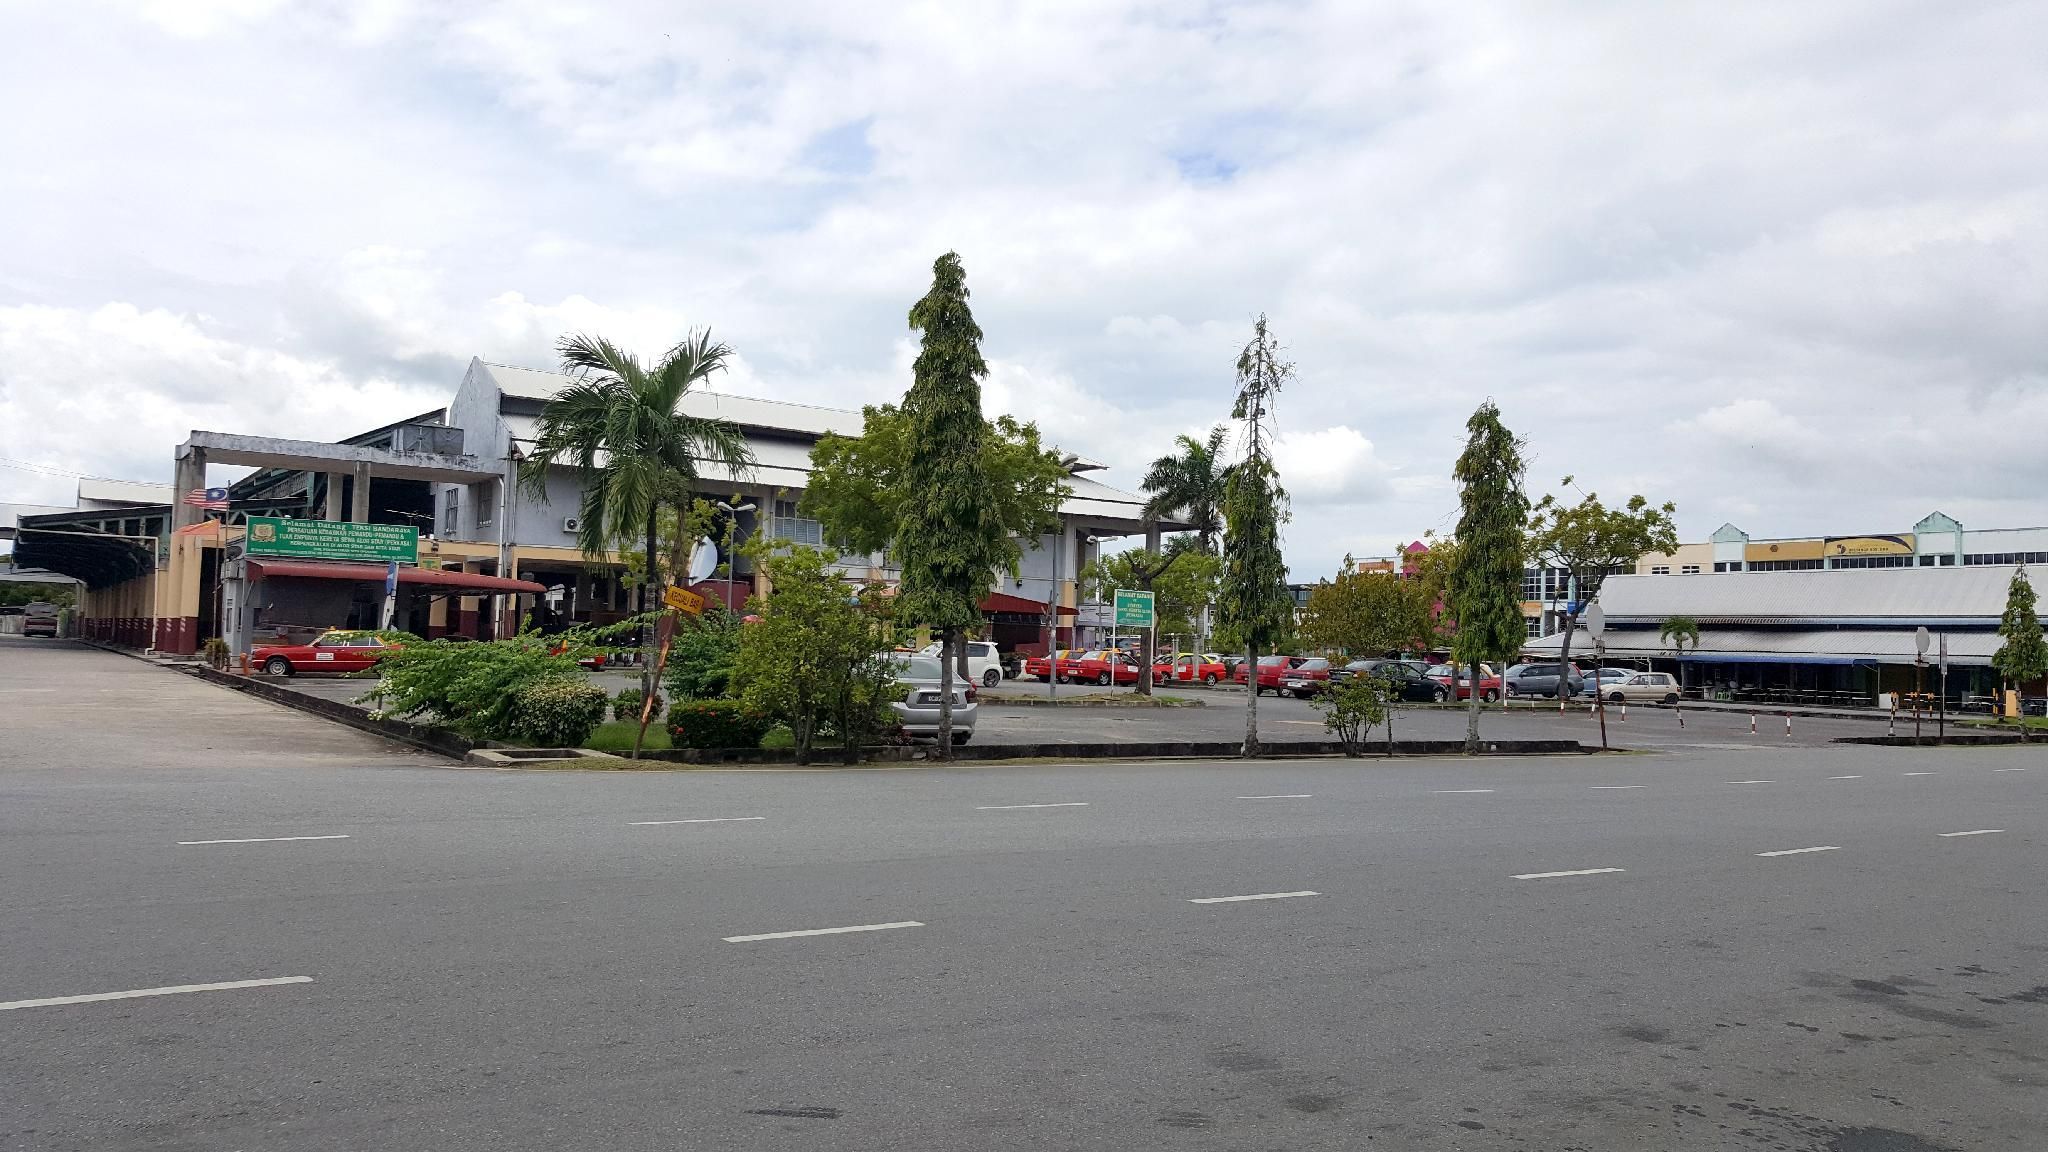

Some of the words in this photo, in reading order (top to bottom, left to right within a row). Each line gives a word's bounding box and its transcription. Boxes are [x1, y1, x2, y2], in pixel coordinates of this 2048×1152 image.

[281, 520, 315, 528] Selamat
[317, 522, 346, 531] Datang
[671, 591, 689, 605] KECUALI
